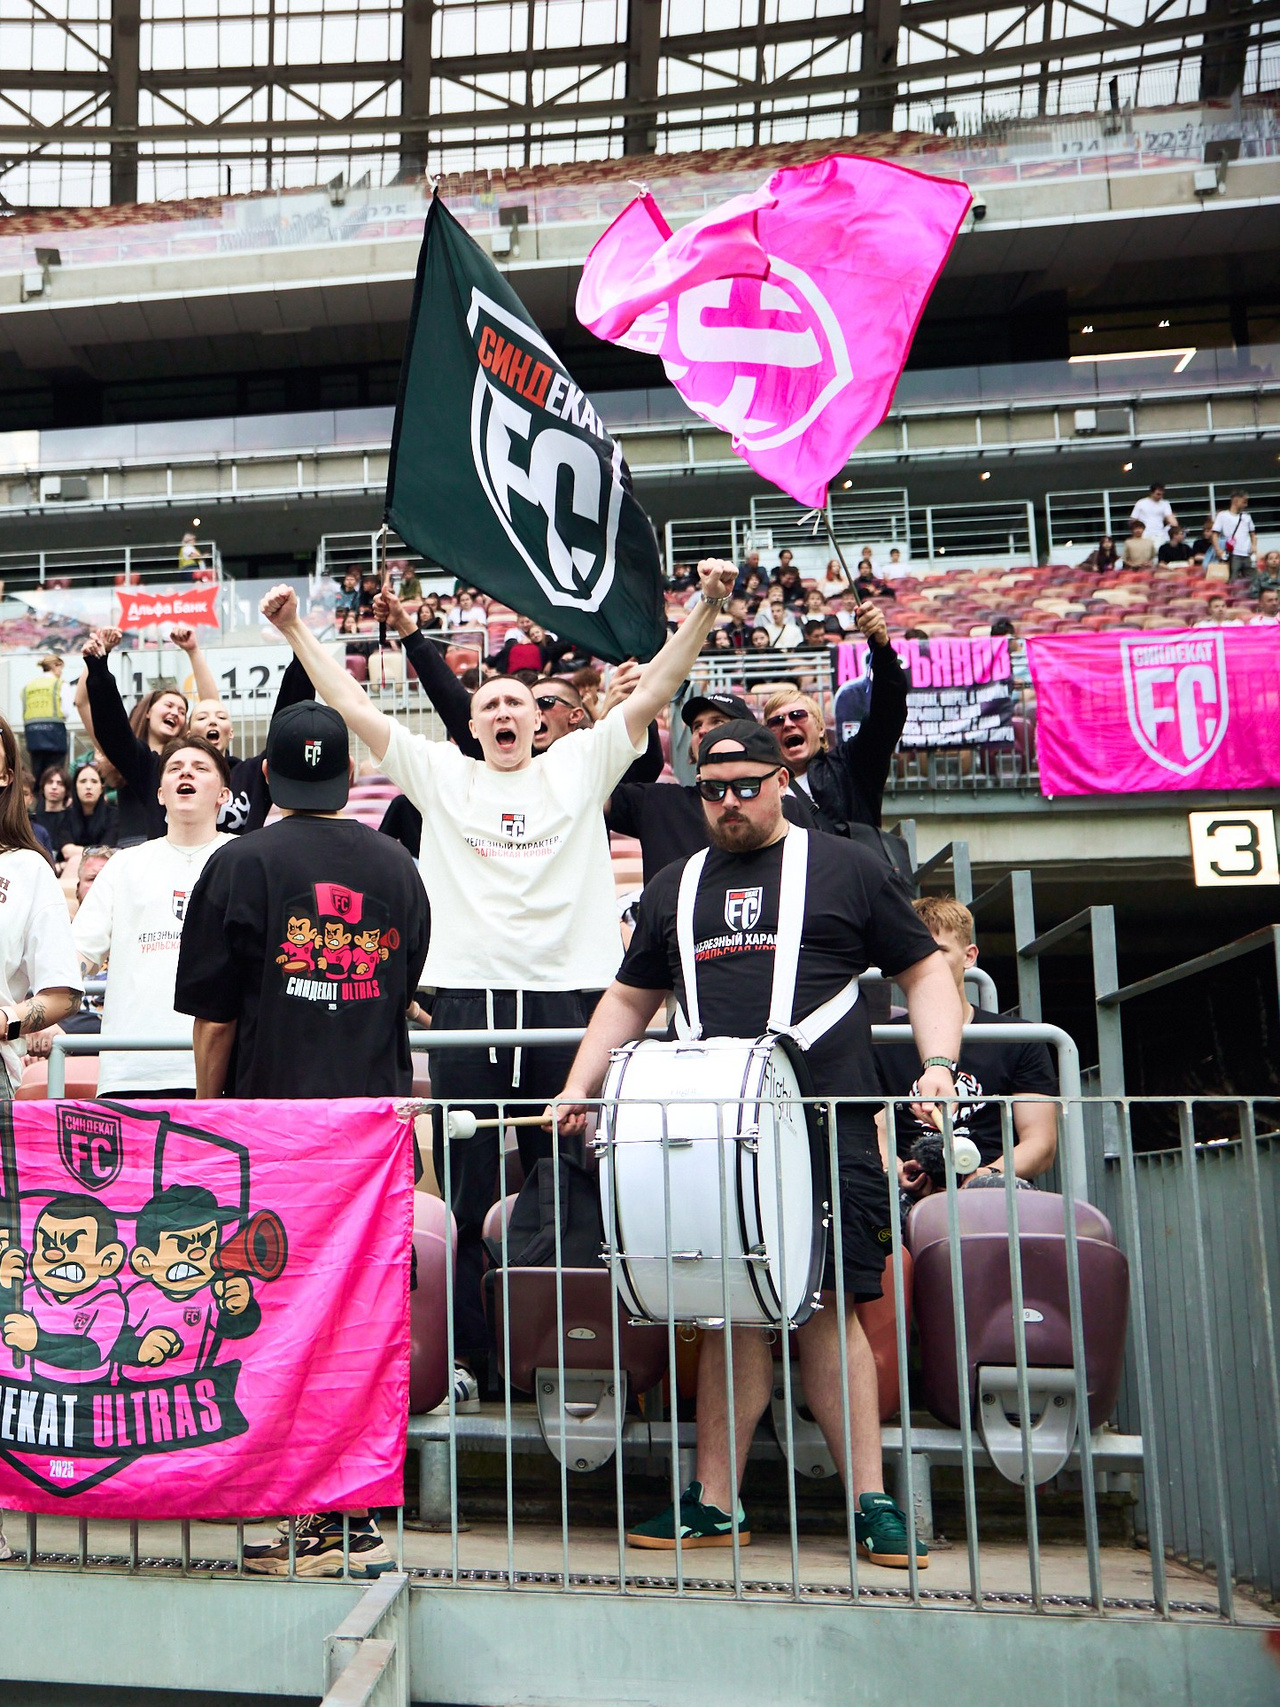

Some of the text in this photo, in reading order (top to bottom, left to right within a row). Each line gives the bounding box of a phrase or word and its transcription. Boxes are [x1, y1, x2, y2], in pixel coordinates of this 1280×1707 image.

[486, 382, 600, 591] FC
[127, 600, 207, 618] Альфа Банк
[1132, 641, 1213, 667] СИНДЕКАТ
[221, 664, 286, 699] 12
[1134, 664, 1217, 761] FC
[305, 745, 322, 767] FC
[1207, 820, 1263, 876] 3
[333, 895, 349, 911] FC
[728, 897, 758, 930] FC
[286, 976, 380, 1001] СИНДЕКАТ ULTRAS
[65, 1114, 115, 1134] СИНДЕКАТ
[70, 1135, 113, 1178] FC
[185, 1311, 199, 1325] FC
[92, 1378, 222, 1448] ULTRAS
[49, 1459, 74, 1478] 2025
